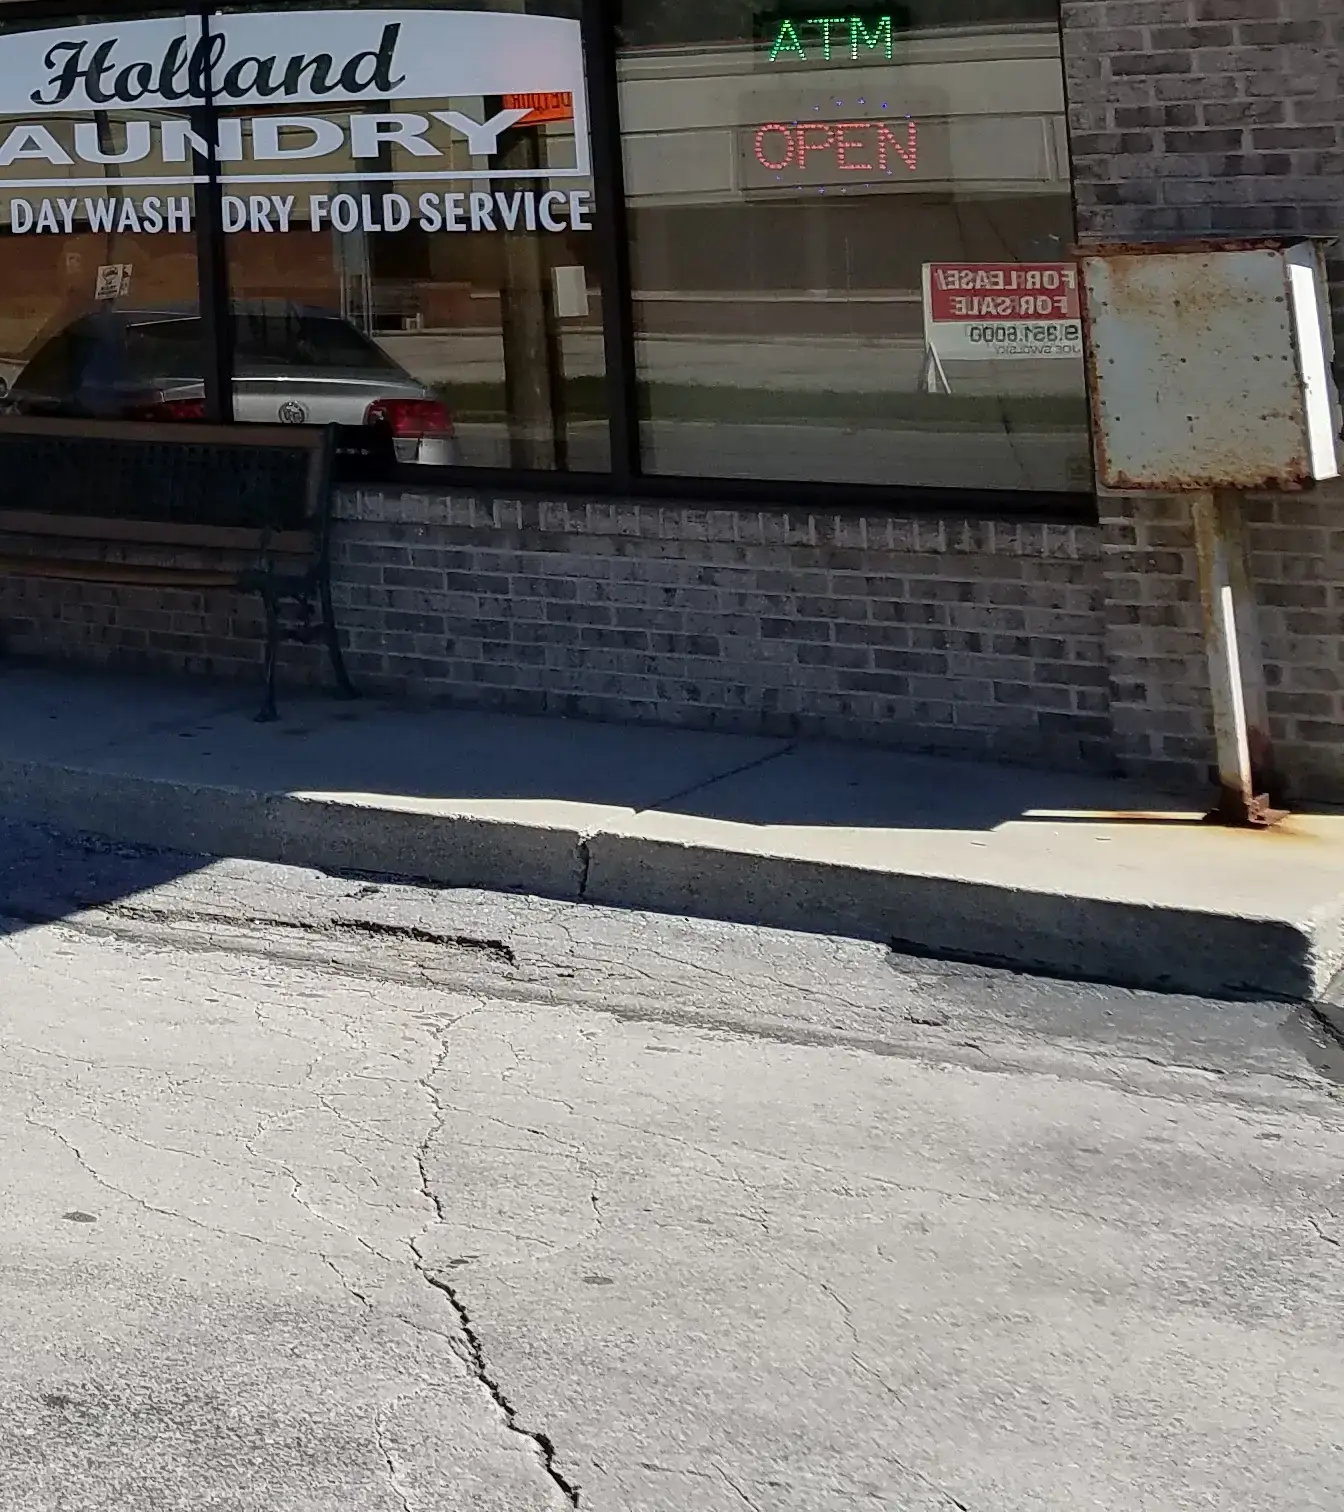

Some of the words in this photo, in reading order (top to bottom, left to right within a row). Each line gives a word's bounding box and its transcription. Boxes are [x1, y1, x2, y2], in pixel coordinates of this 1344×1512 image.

[768, 16, 895, 61] ATM
[30, 22, 407, 105] Holland
[753, 121, 919, 171] OPEN
[11, 198, 78, 234] DAY
[85, 196, 193, 234] WASH
[222, 195, 296, 234] DRY
[312, 194, 412, 233] FOLD
[419, 190, 593, 233] SERVICE
